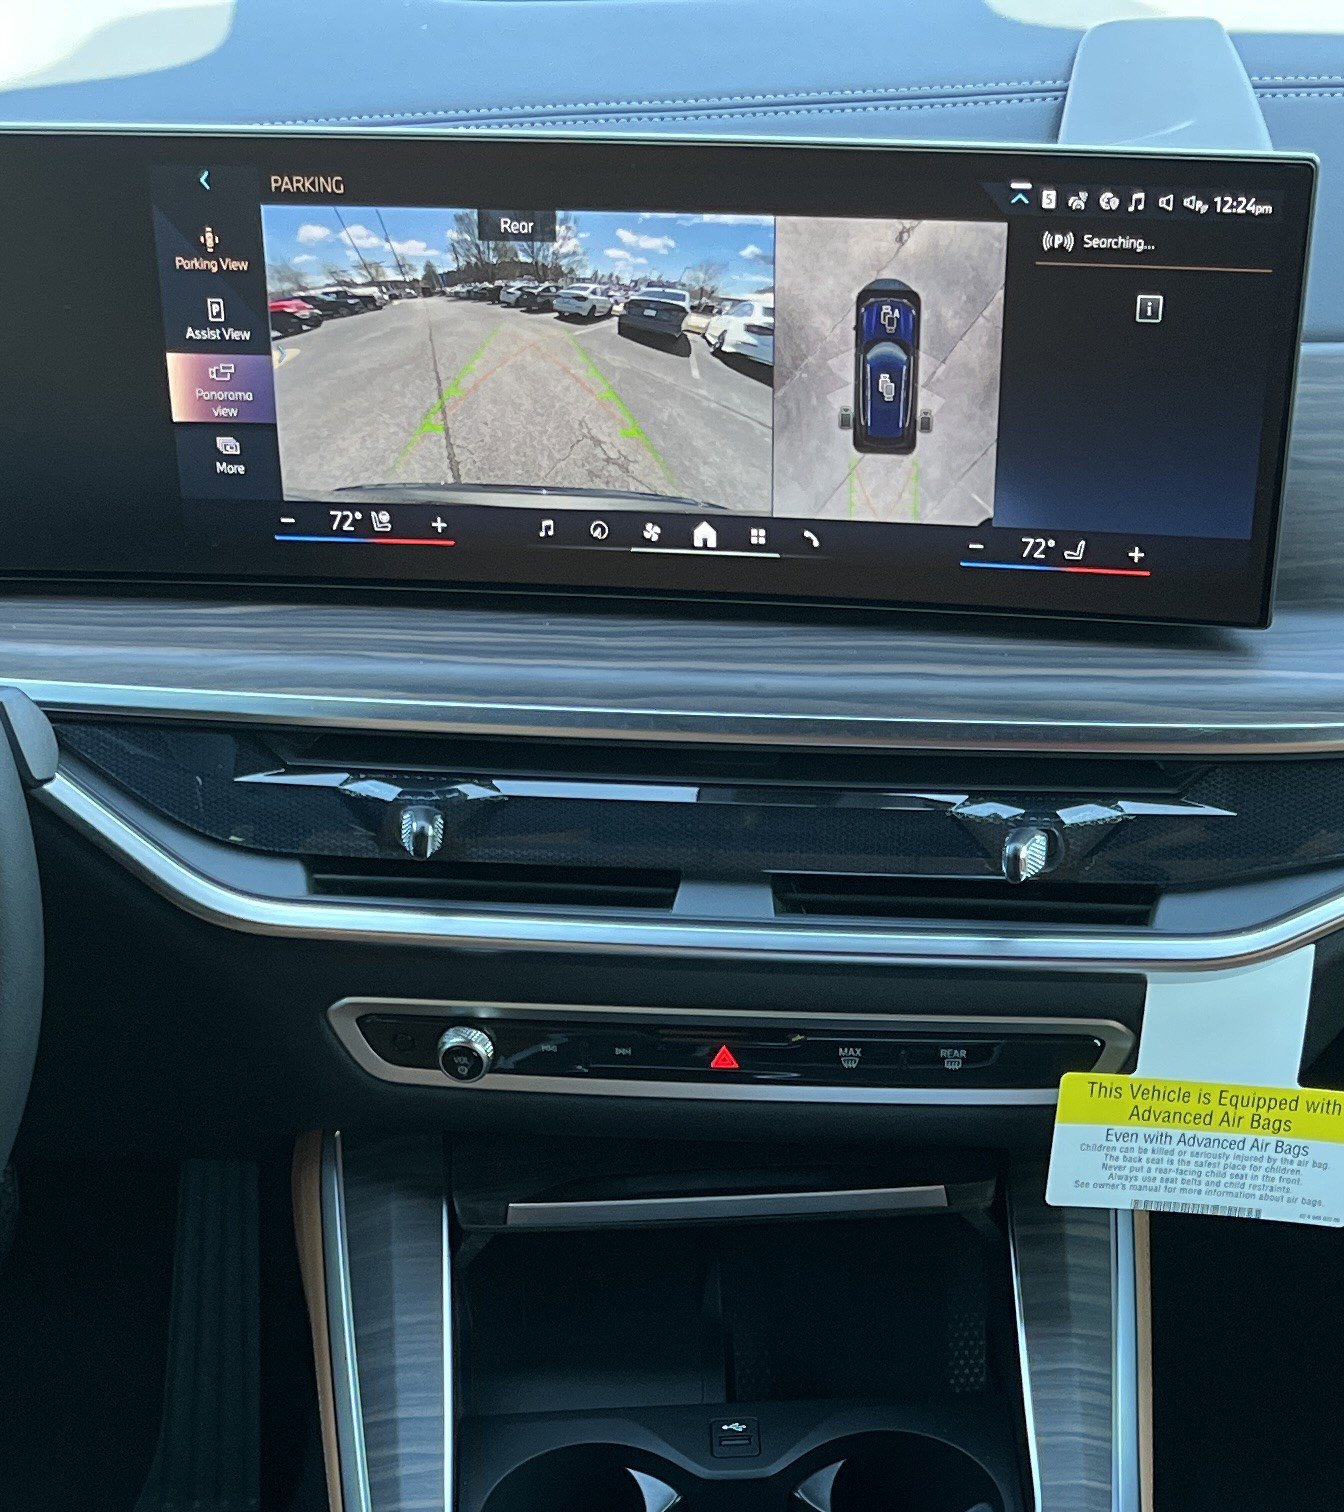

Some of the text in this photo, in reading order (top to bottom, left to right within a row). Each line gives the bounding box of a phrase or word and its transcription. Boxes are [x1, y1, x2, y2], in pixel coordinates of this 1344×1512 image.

[270, 175, 345, 194] PARKING
[500, 217, 535, 234] Rear
[1083, 234, 1155, 253] Searching...
[175, 256, 249, 273] Parking View
[185, 326, 251, 341] Assist View
[195, 388, 253, 401] Panorama
[211, 405, 239, 417] view
[215, 461, 245, 475] More
[329, 510, 363, 531] 72°
[1021, 537, 1056, 559] 72°
[838, 1047, 862, 1057] MAX
[940, 1049, 967, 1059] REAR
[1088, 1081, 1342, 1117] This Vehicle is Equipped with
[1128, 1104, 1293, 1135] Advanced Air Bags
[1105, 1128, 1310, 1158] Even with Advanced Air Bags
[1079, 1143, 1117, 1152] Children
[1119, 1146, 1135, 1154] can
[1138, 1145, 1149, 1155] be
[1151, 1146, 1175, 1157] killed
[1177, 1149, 1187, 1157] or
[1190, 1149, 1231, 1162] seriously
[1233, 1152, 1265, 1164] injured
[1267, 1155, 1278, 1166] by
[1280, 1156, 1294, 1166] the
[1297, 1158, 1309, 1168] air
[1103, 1153, 1119, 1162] The
[1122, 1154, 1143, 1164] back
[1145, 1155, 1164, 1165] seat
[1167, 1157, 1174, 1166] is
[1177, 1158, 1191, 1167] the
[1194, 1159, 1220, 1169] safest
[1223, 1161, 1247, 1172] place
[1249, 1163, 1262, 1172] for
[1101, 1162, 1126, 1172] Never
[1129, 1164, 1144, 1175] put
[1154, 1167, 1202, 1178] rear-facing
[1205, 1170, 1227, 1179] child
[1229, 1172, 1248, 1181] seat
[1251, 1173, 1259, 1181] in
[1261, 1173, 1276, 1183] the
[1107, 1172, 1139, 1183] Always
[1141, 1175, 1157, 1183] use
[1159, 1176, 1178, 1186] seat
[1181, 1177, 1202, 1187] belts
[1205, 1179, 1221, 1188] and
[1223, 1181, 1246, 1190] child
[1074, 1180, 1090, 1189] See
[1129, 1183, 1161, 1193] manual
[1163, 1184, 1176, 1194] for
[1179, 1187, 1203, 1196] more
[1205, 1188, 1256, 1200] information
[1258, 1191, 1285, 1202] about
[1286, 1194, 1300, 1204] air
